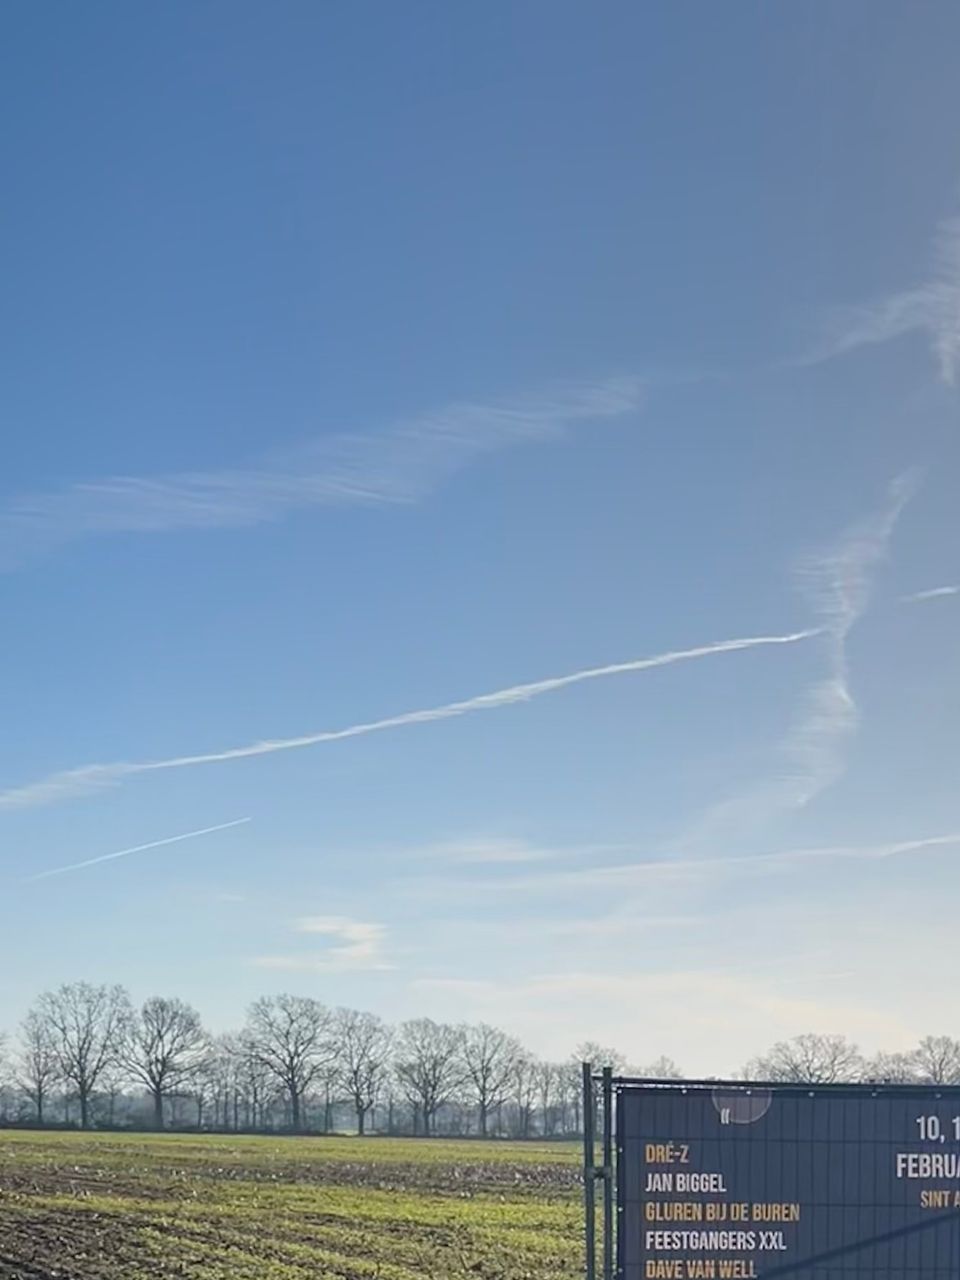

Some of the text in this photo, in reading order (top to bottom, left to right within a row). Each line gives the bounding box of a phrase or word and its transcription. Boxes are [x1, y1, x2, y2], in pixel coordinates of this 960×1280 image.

[916, 1115, 945, 1143] 10,
[645, 1141, 689, 1163] DRÉ-Z
[645, 1173, 727, 1192] JAN BIGGEL
[920, 1190, 951, 1208] SINT
[645, 1202, 800, 1221] GLUREN BIJ DE BUREN
[646, 1231, 787, 1250] FEESTGANGERS XXL
[646, 1260, 757, 1279] DAVE VAN WELL
